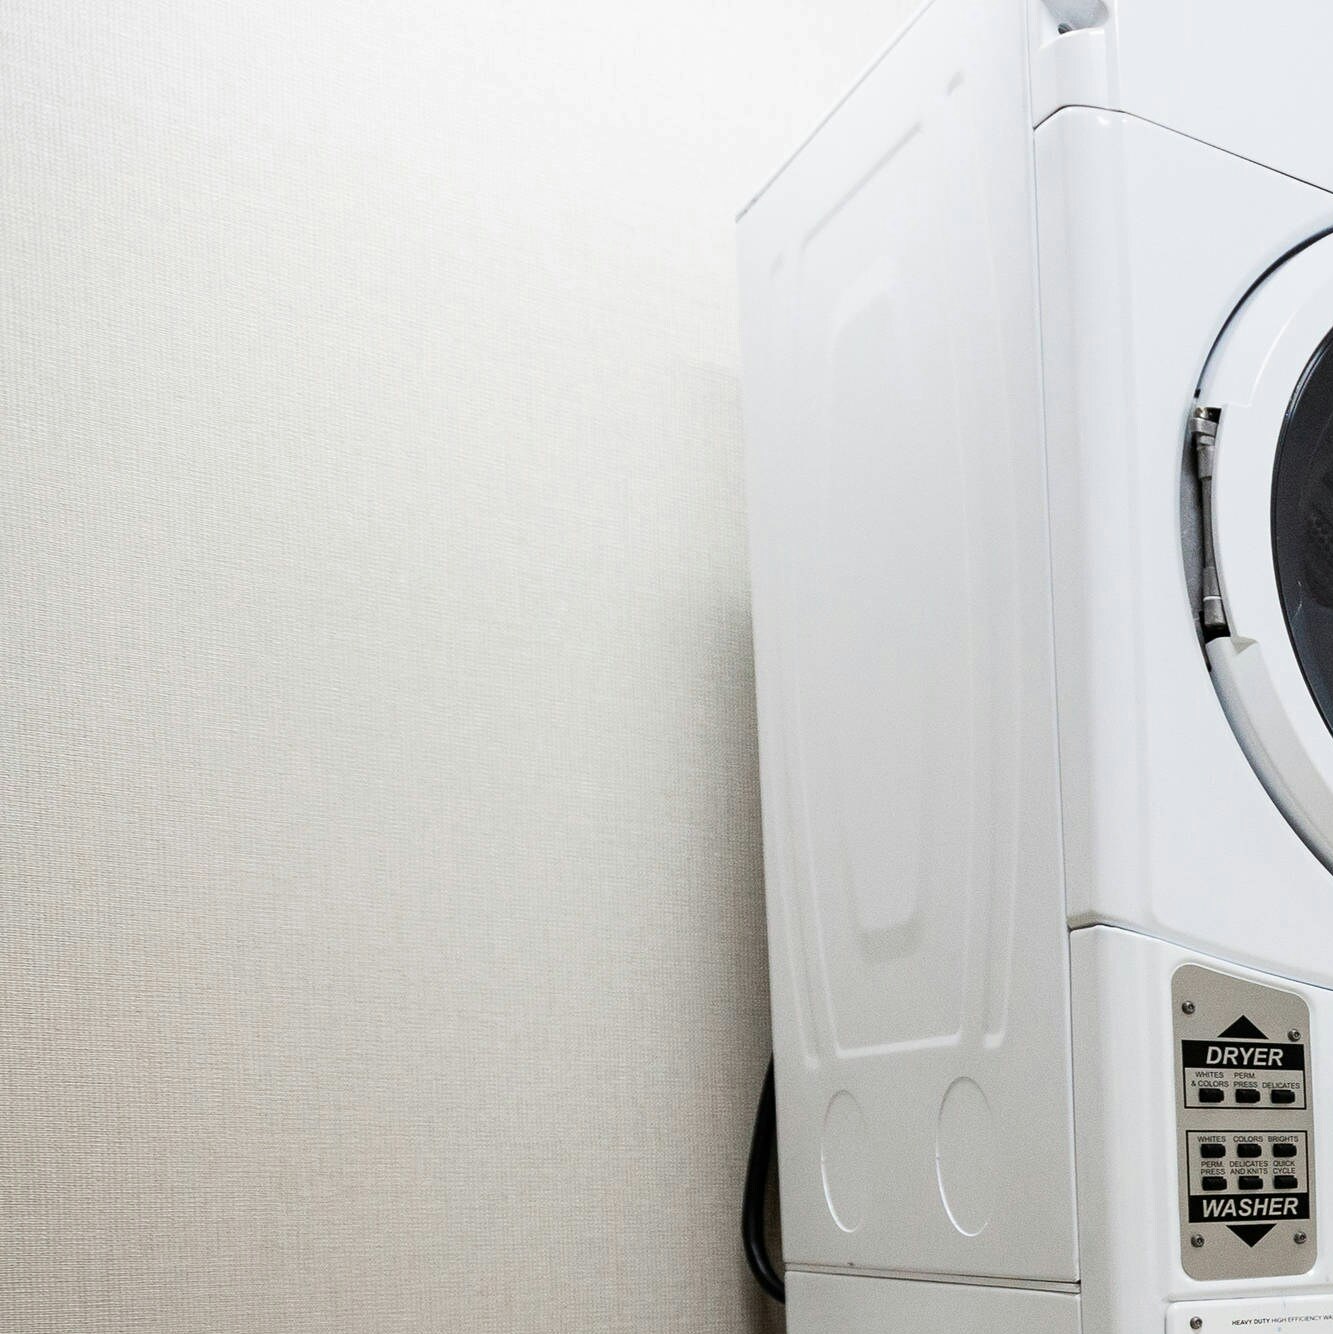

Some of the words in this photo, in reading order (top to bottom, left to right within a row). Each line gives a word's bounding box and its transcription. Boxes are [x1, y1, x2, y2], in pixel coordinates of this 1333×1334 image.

[1206, 1046, 1283, 1066] DRYER
[1202, 1198, 1299, 1217] WASHER
[1288, 1315, 1322, 1323] EFFICIENCY
